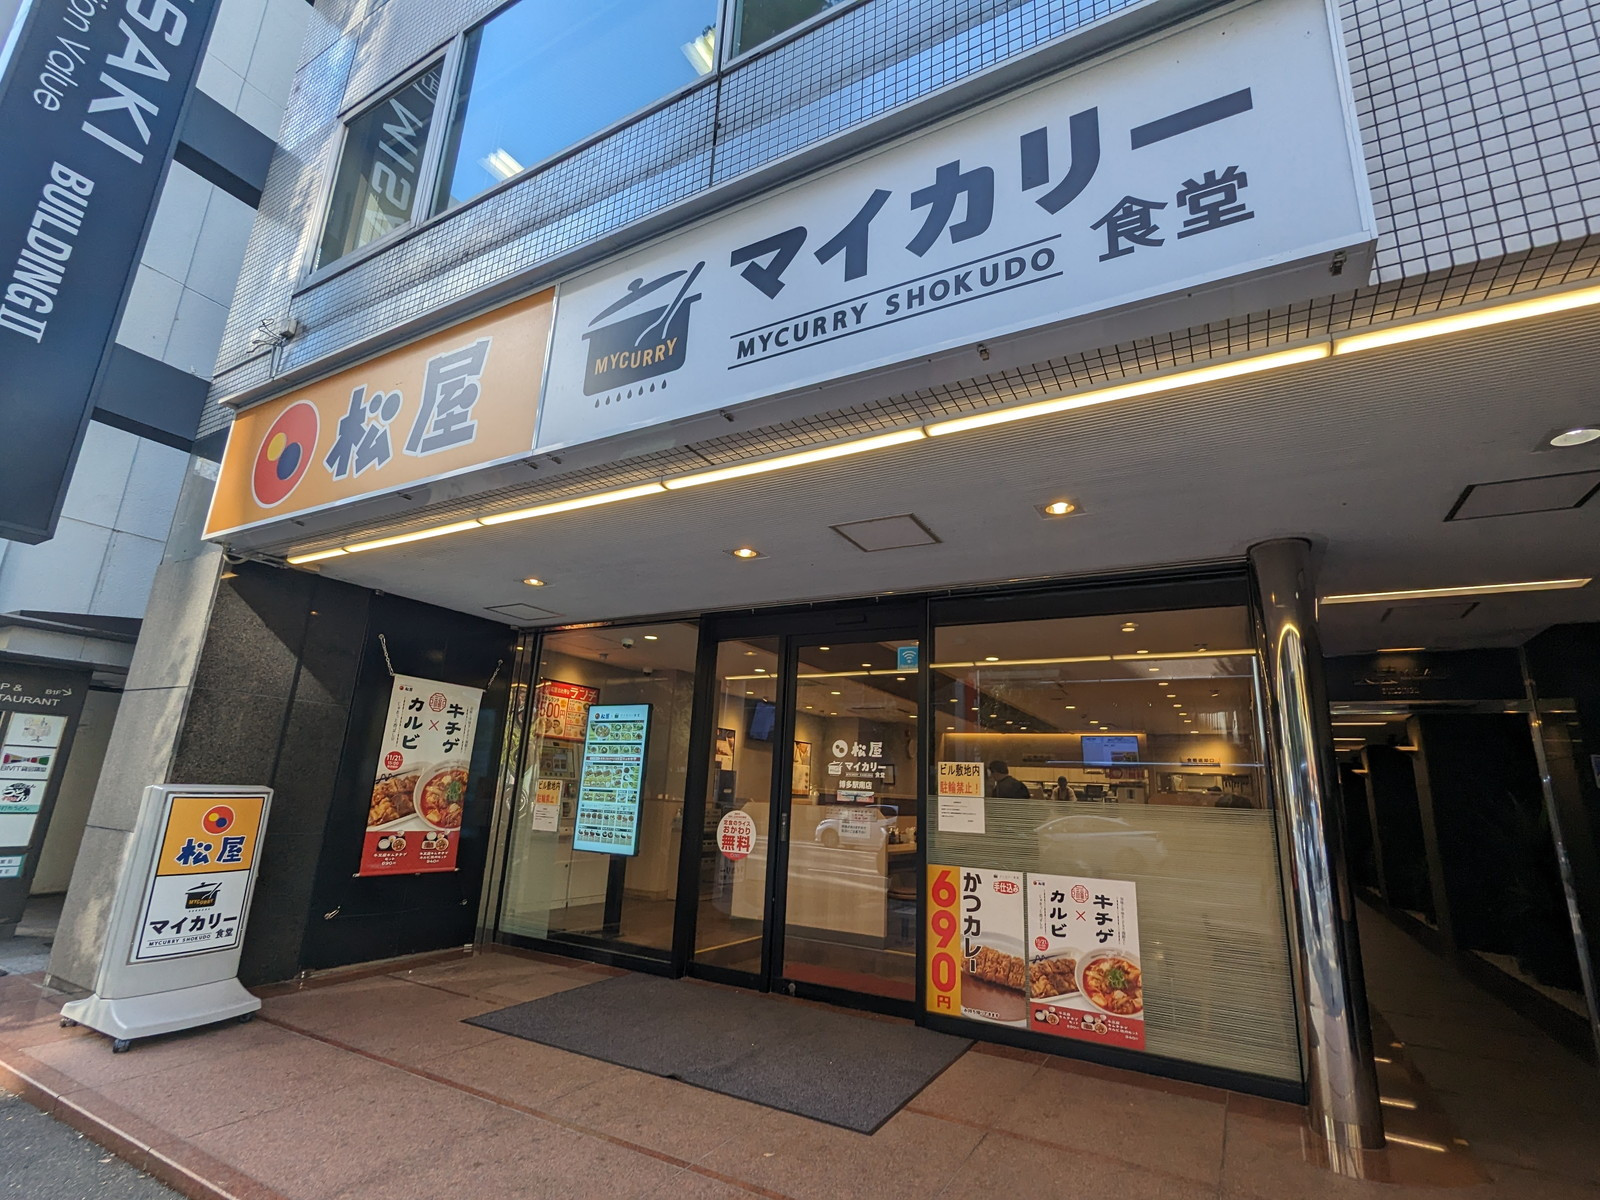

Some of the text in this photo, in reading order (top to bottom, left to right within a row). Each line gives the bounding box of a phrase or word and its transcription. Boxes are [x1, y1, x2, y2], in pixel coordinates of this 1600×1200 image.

[33, 36, 91, 112] Value
[81, 0, 195, 164] SAKI
[730, 87, 1254, 300] マイカリー
[1089, 165, 1255, 262] 食堂
[5, 161, 95, 314] BUILDING
[736, 247, 1056, 360] MYCURRY SHOKUDO
[594, 337, 678, 375] MYCURRY
[323, 336, 493, 482] 松屋
[402, 697, 425, 750] カルビ
[442, 703, 465, 754] 牛チゲ
[844, 762, 887, 772] マイカリー
[850, 741, 883, 758] 松屋
[940, 763, 981, 777] ビル敷地内
[175, 835, 246, 866] 松屋
[721, 834, 751, 853] 無料
[723, 826, 751, 836] おかわり
[149, 912, 238, 935] マイカリー
[215, 927, 234, 939] 食堂
[962, 871, 983, 974] かつカレー
[1049, 890, 1068, 938] カルビ
[1093, 894, 1115, 944] 牛チゲ
[148, 934, 211, 946] MYCURRY SHOKUDO
[931, 870, 957, 1010] 690円
